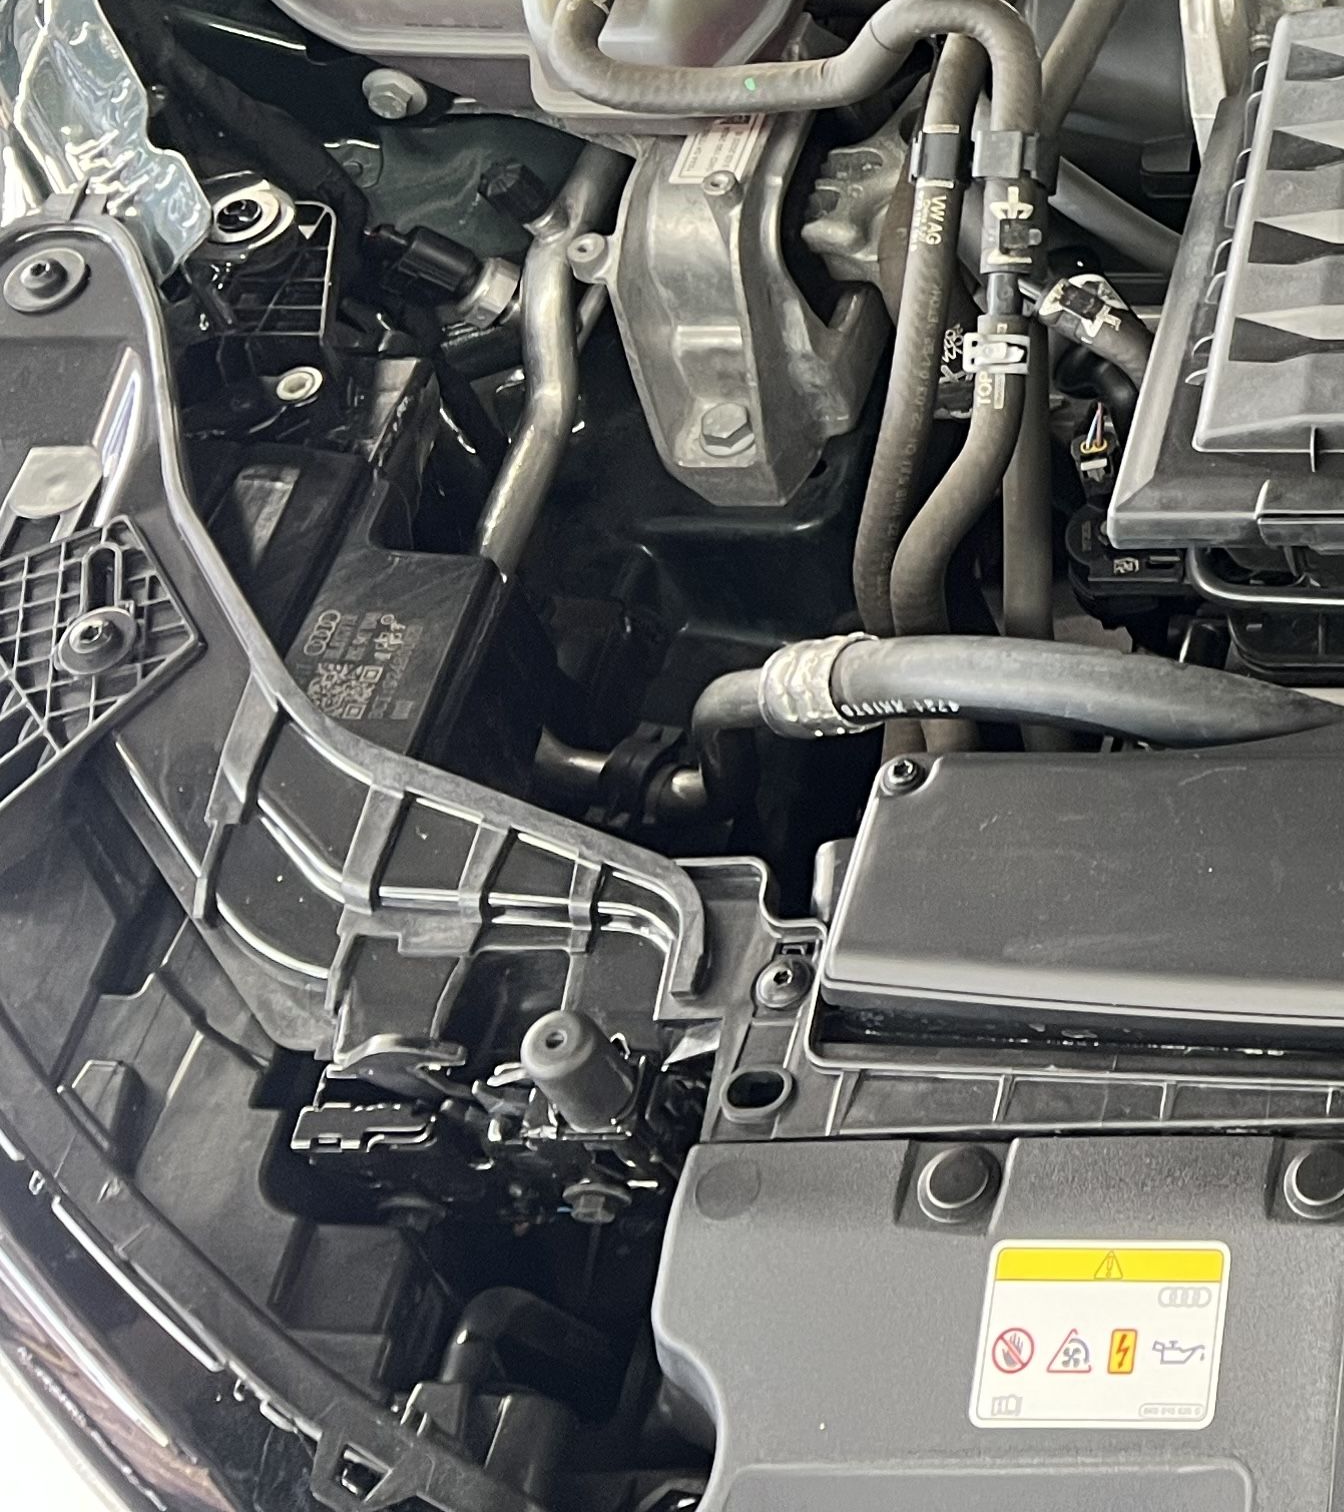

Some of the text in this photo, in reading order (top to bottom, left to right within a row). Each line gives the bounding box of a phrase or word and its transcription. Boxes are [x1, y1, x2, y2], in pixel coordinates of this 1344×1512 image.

[926, 195, 947, 245] VW AG
[977, 370, 992, 408] TOP
